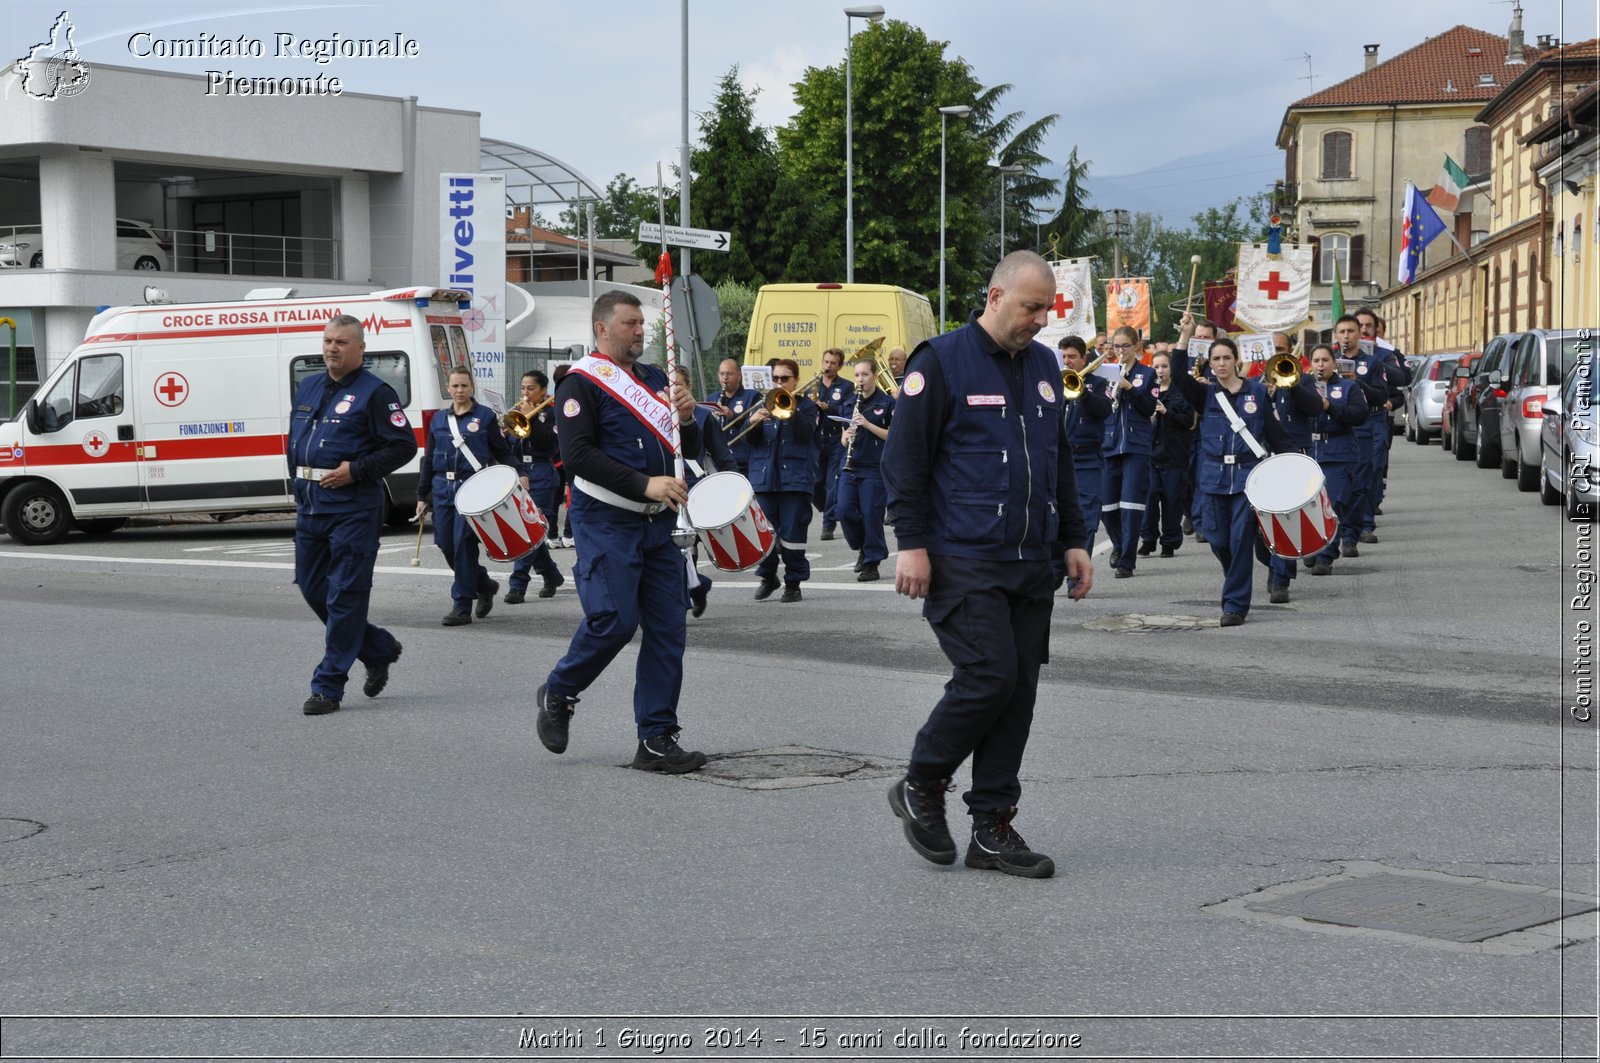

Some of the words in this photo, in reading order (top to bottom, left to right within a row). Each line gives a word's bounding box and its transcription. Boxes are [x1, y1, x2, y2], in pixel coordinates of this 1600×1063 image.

[162, 314, 214, 328] CROCE
[218, 312, 269, 325] ROSSA
[273, 308, 343, 322] ITALIANA
[778, 339, 811, 347] SERVIZIO
[791, 349, 797, 357] A
[624, 384, 662, 419] CROCE
[179, 422, 225, 436] FONDAZIONE
[233, 421, 246, 433] CRT
